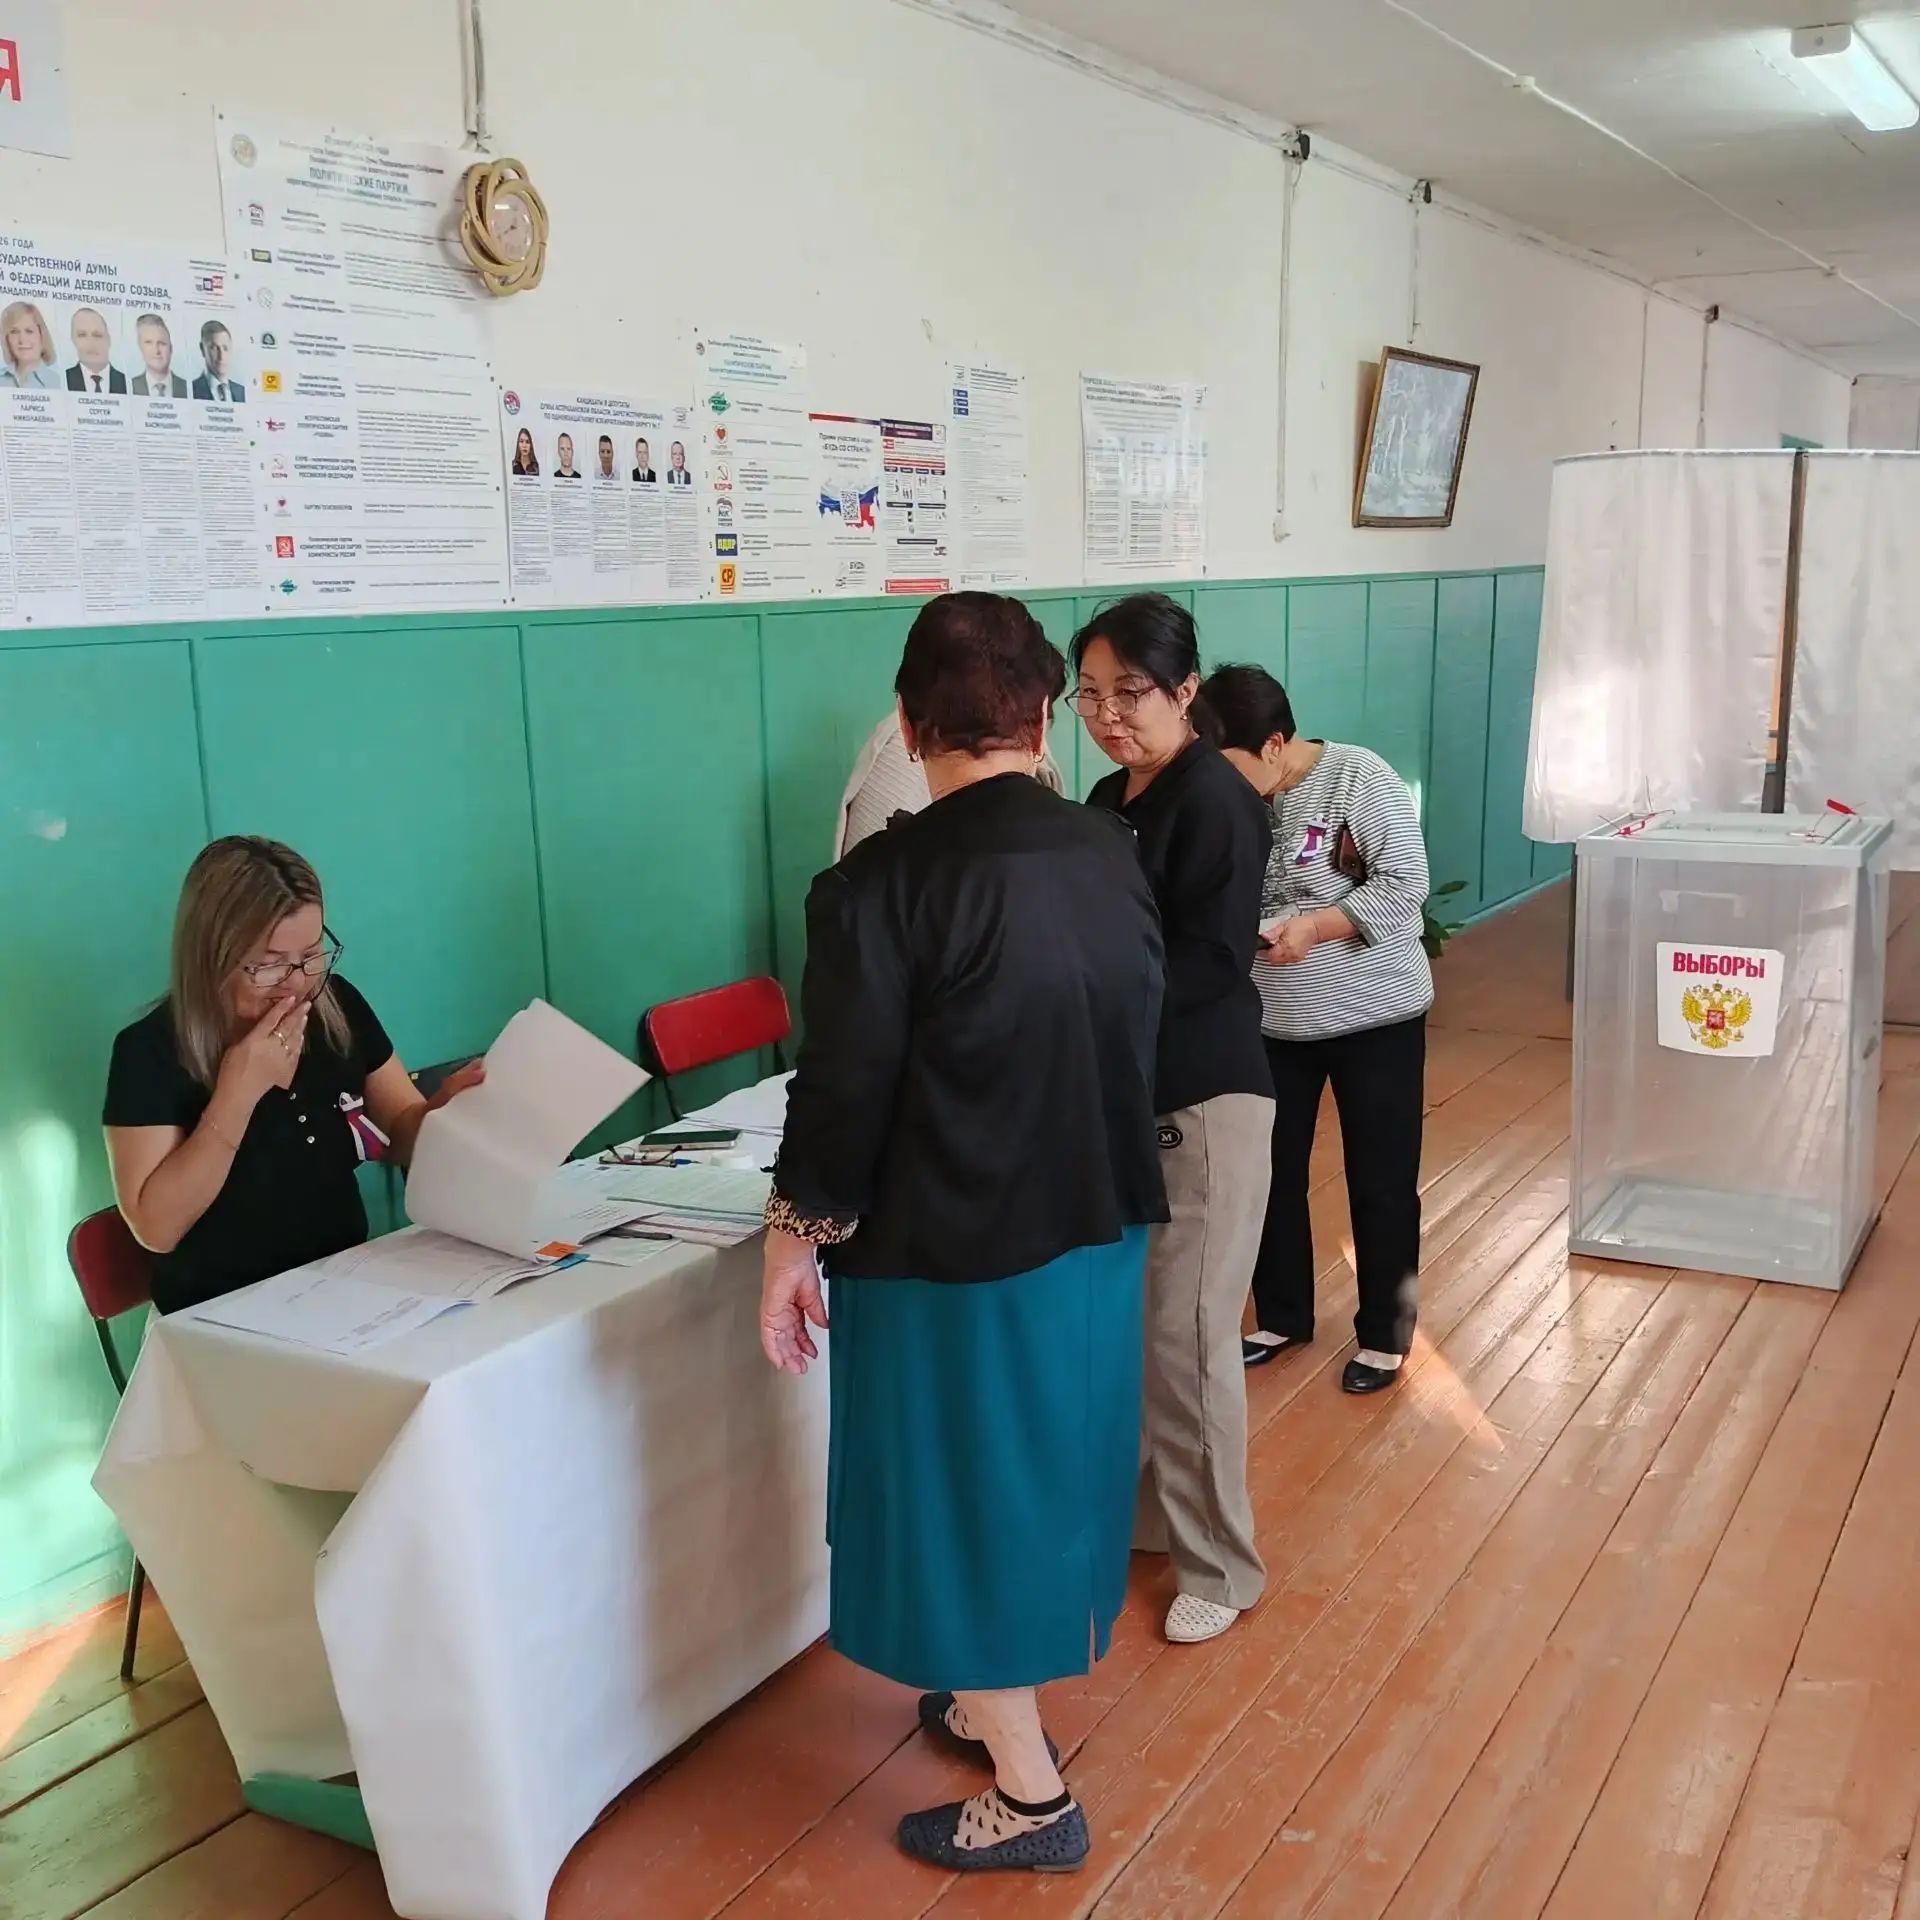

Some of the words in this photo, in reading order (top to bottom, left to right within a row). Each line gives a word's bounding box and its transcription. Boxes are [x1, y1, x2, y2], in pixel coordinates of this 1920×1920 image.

[12, 238, 34, 249] ГОДА
[86, 263, 117, 276] ДУМЫ
[9, 272, 70, 288] ФЕДЕРАЦИИ
[75, 279, 125, 294] ДЕВЯТОГО
[130, 284, 172, 299] СОЗЫВА,
[52, 292, 122, 305] ИЗБИРАТЕЛЬНОМУ
[126, 299, 151, 310] ОКРУГУ
[1673, 951, 1766, 979] ВЫБОРЫ
